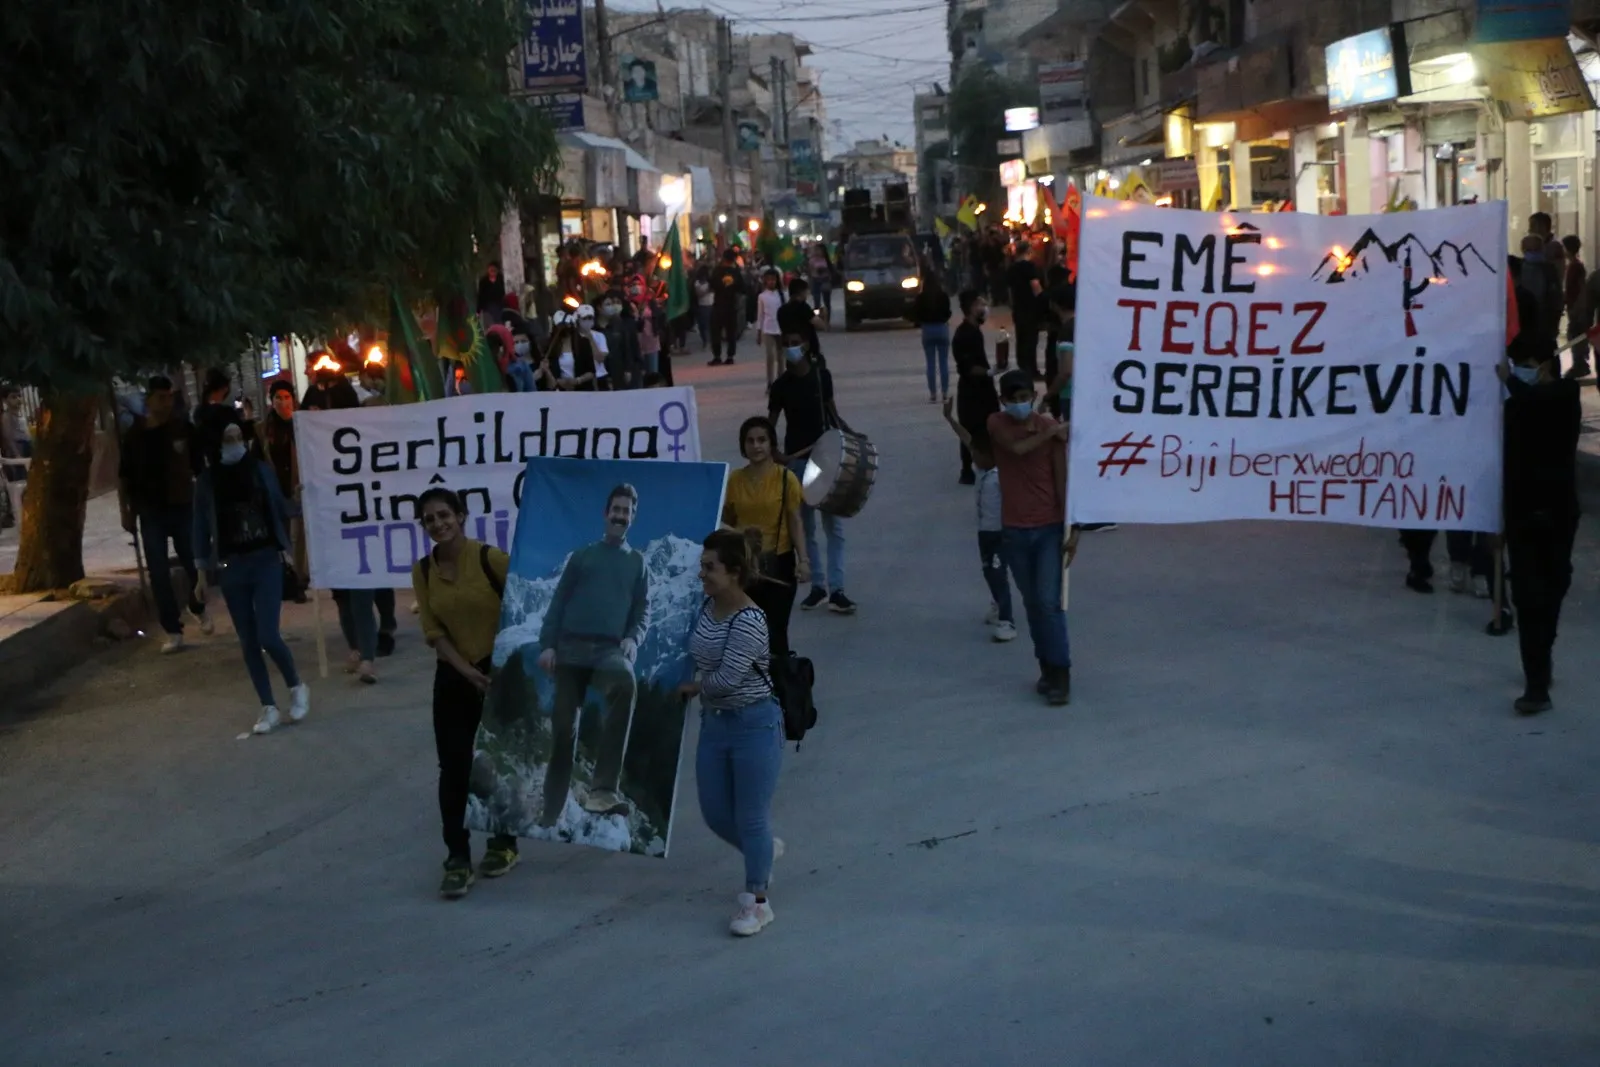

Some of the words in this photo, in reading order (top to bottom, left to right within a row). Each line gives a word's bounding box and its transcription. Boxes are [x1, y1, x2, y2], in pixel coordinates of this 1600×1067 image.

[1120, 222, 1261, 293] EMÊ
[1117, 298, 1327, 357] TEQEZ
[333, 407, 658, 474] Serhildana
[1229, 437, 1414, 477] berxwedana
[336, 473, 491, 524] Jinn
